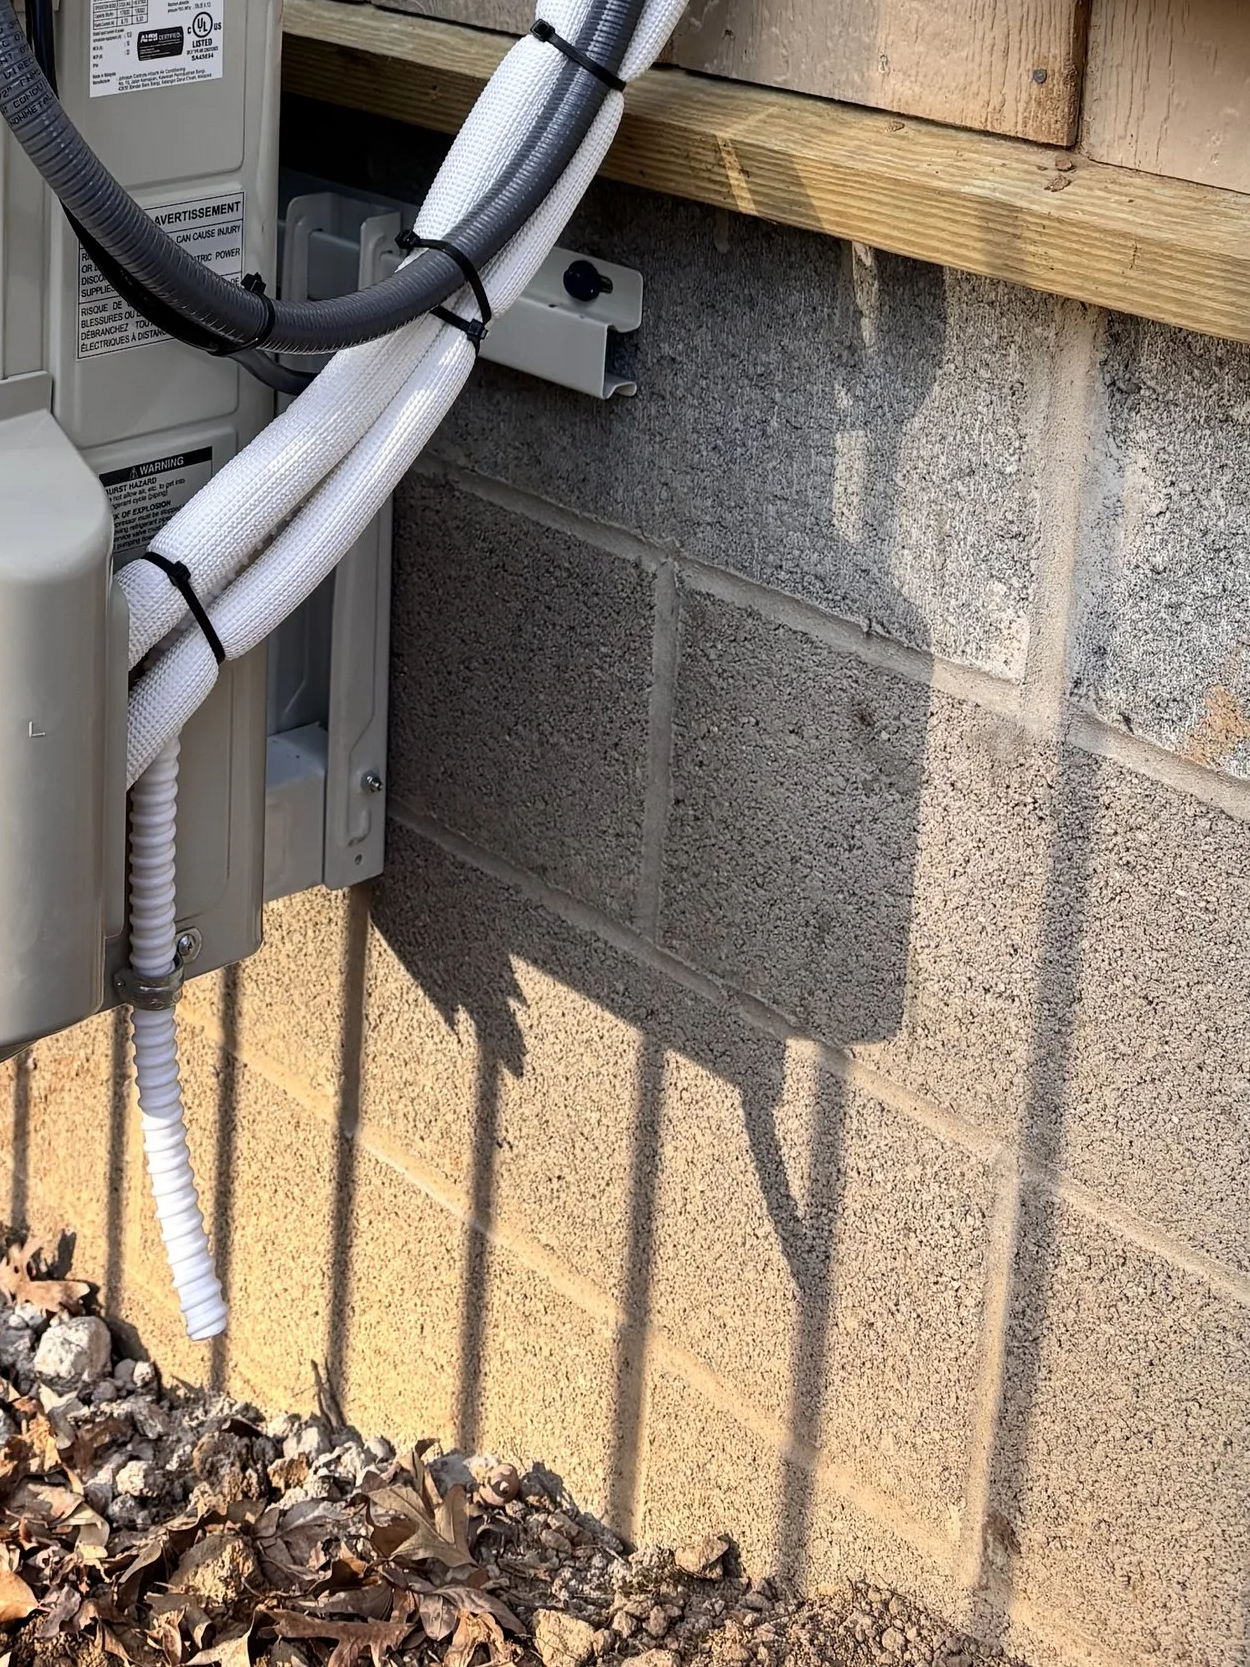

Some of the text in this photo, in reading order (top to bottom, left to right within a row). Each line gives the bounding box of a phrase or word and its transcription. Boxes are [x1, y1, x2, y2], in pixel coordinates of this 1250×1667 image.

[192, 37, 213, 48] LISTED
[154, 201, 241, 226] AVERTISSEMENT
[176, 224, 241, 244] CAN CAUSE INJURY
[215, 247, 240, 260] POWER
[81, 264, 92, 274] OR
[81, 300, 122, 316] RISQUE DE
[81, 312, 123, 328] BLESSURES
[124, 310, 135, 319] OU
[80, 323, 129, 341] DÉBRANCHEZ
[80, 334, 130, 353] ÉLECTRIQUES
[139, 456, 184, 475] WARNING
[129, 477, 157, 490] HAZARD
[121, 510, 131, 518] OF
[132, 500, 171, 515] EXPLOSION
